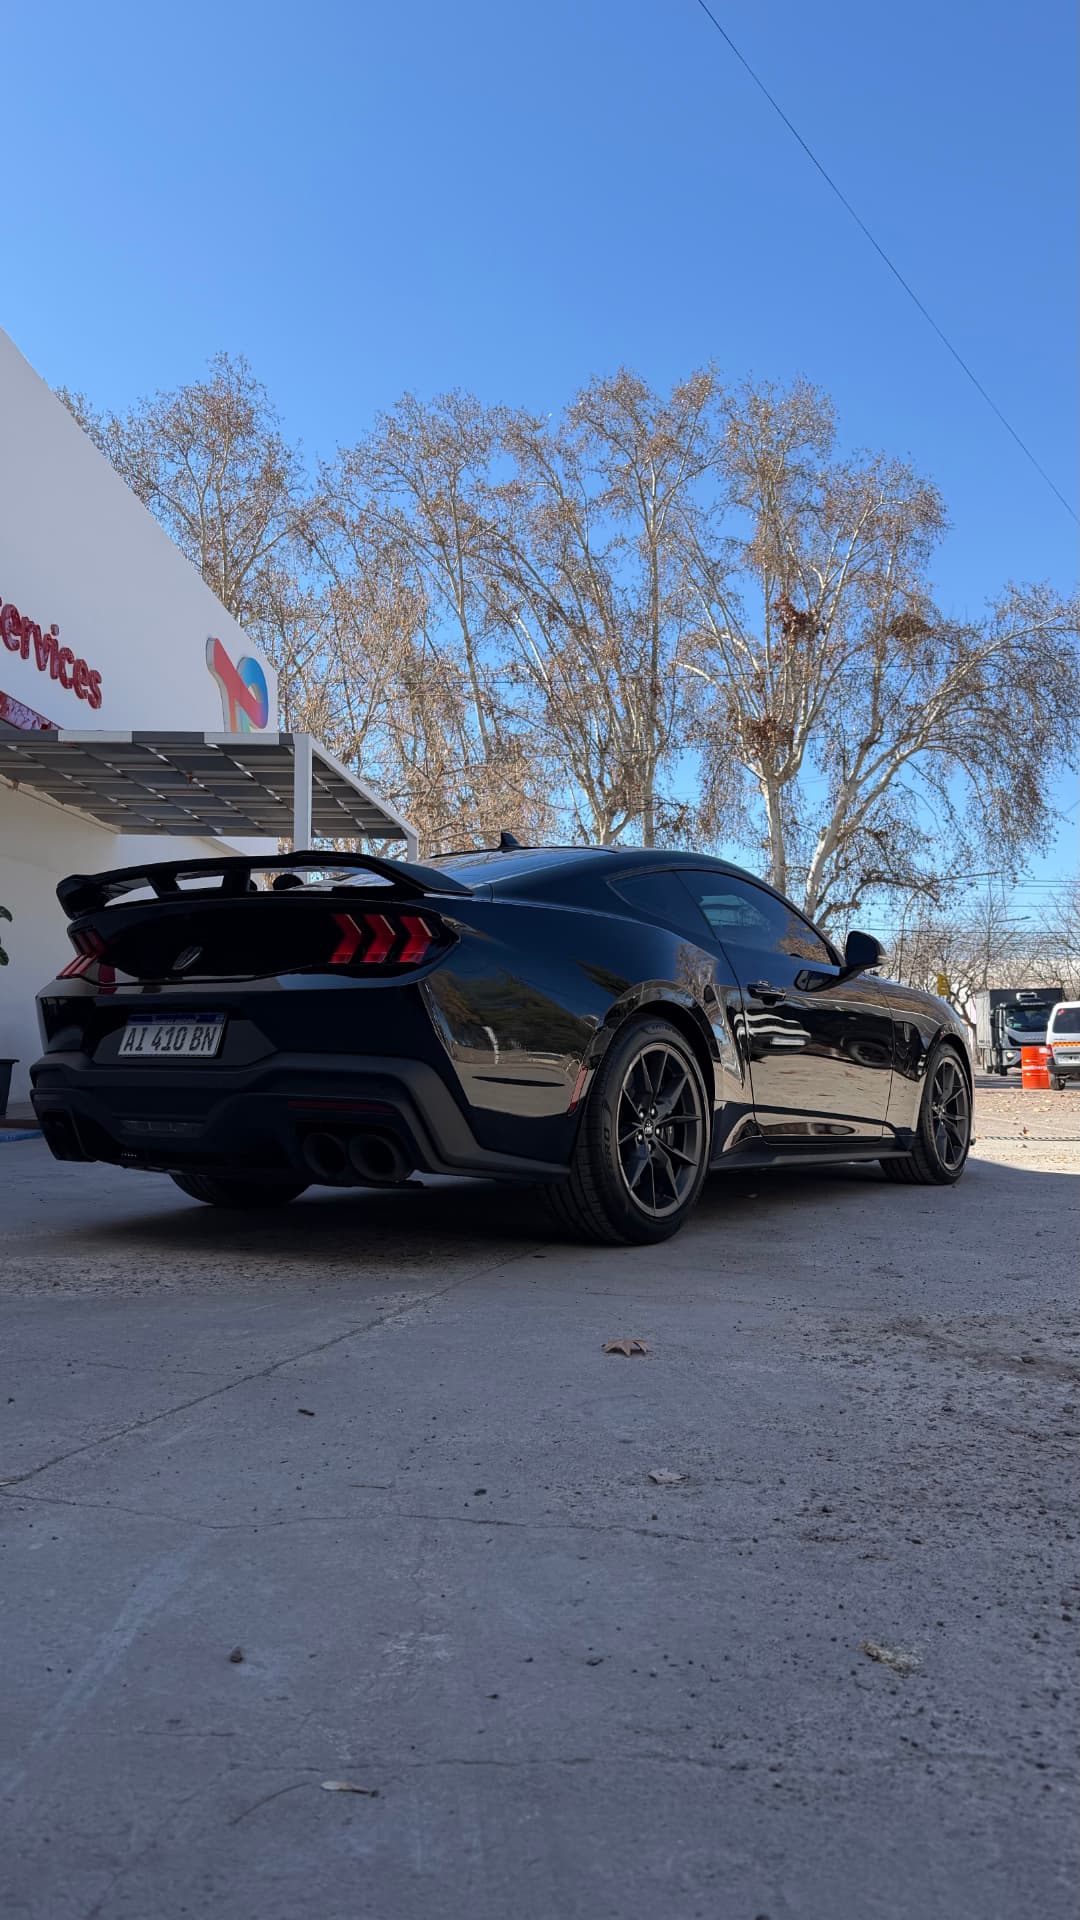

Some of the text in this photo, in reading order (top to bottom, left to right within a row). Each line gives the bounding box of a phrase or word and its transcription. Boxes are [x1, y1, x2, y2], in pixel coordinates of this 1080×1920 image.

[0, 597, 102, 709] ervices
[123, 1026, 217, 1051] AI 410 BN
